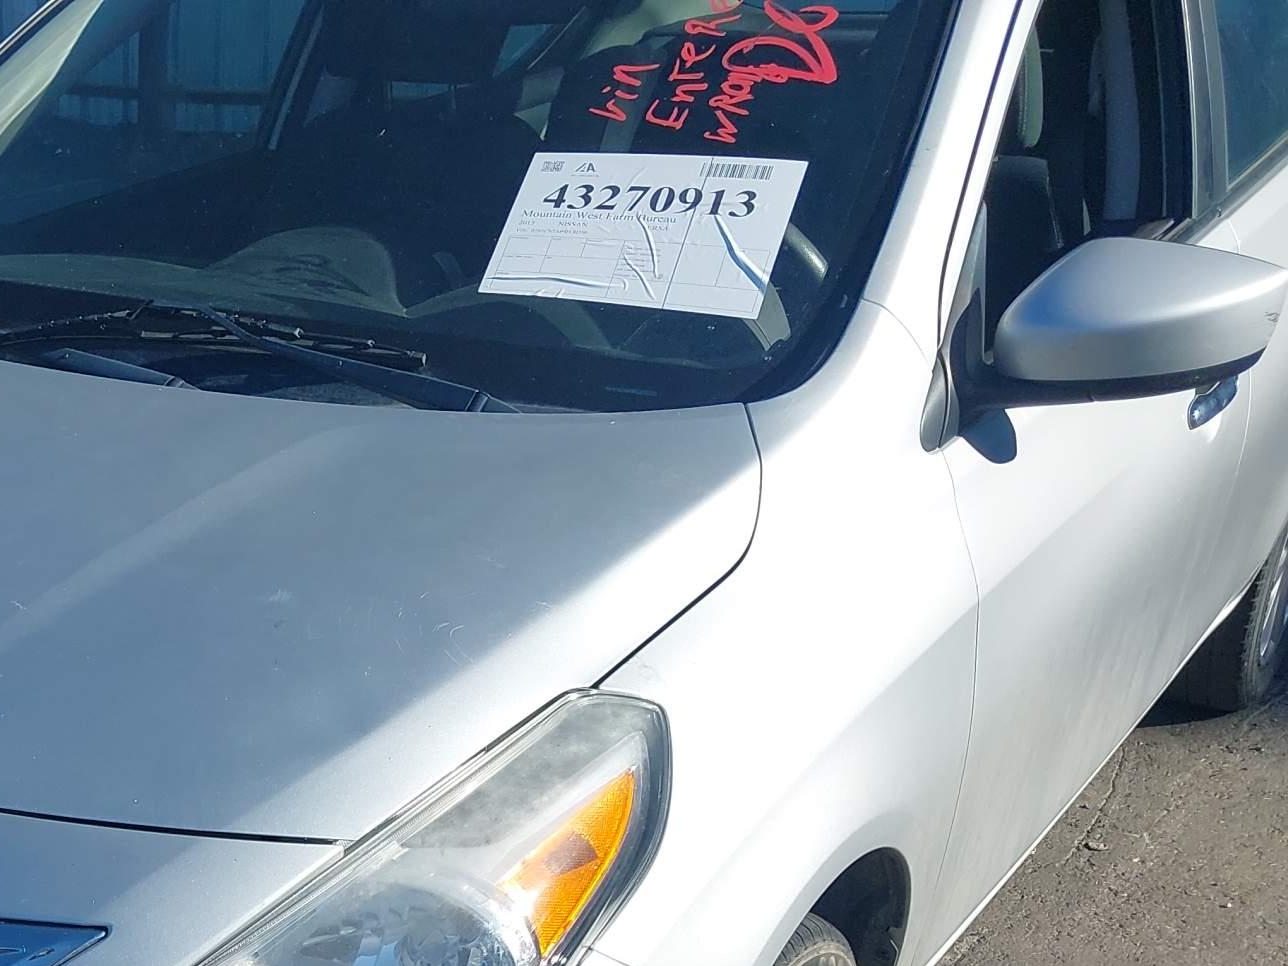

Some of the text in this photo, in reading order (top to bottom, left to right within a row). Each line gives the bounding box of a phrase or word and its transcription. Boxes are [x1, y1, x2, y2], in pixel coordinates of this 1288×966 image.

[543, 183, 758, 218] 43270913
[522, 209, 572, 219] Mountain
[576, 211, 603, 221] West
[605, 212, 634, 221] Farm
